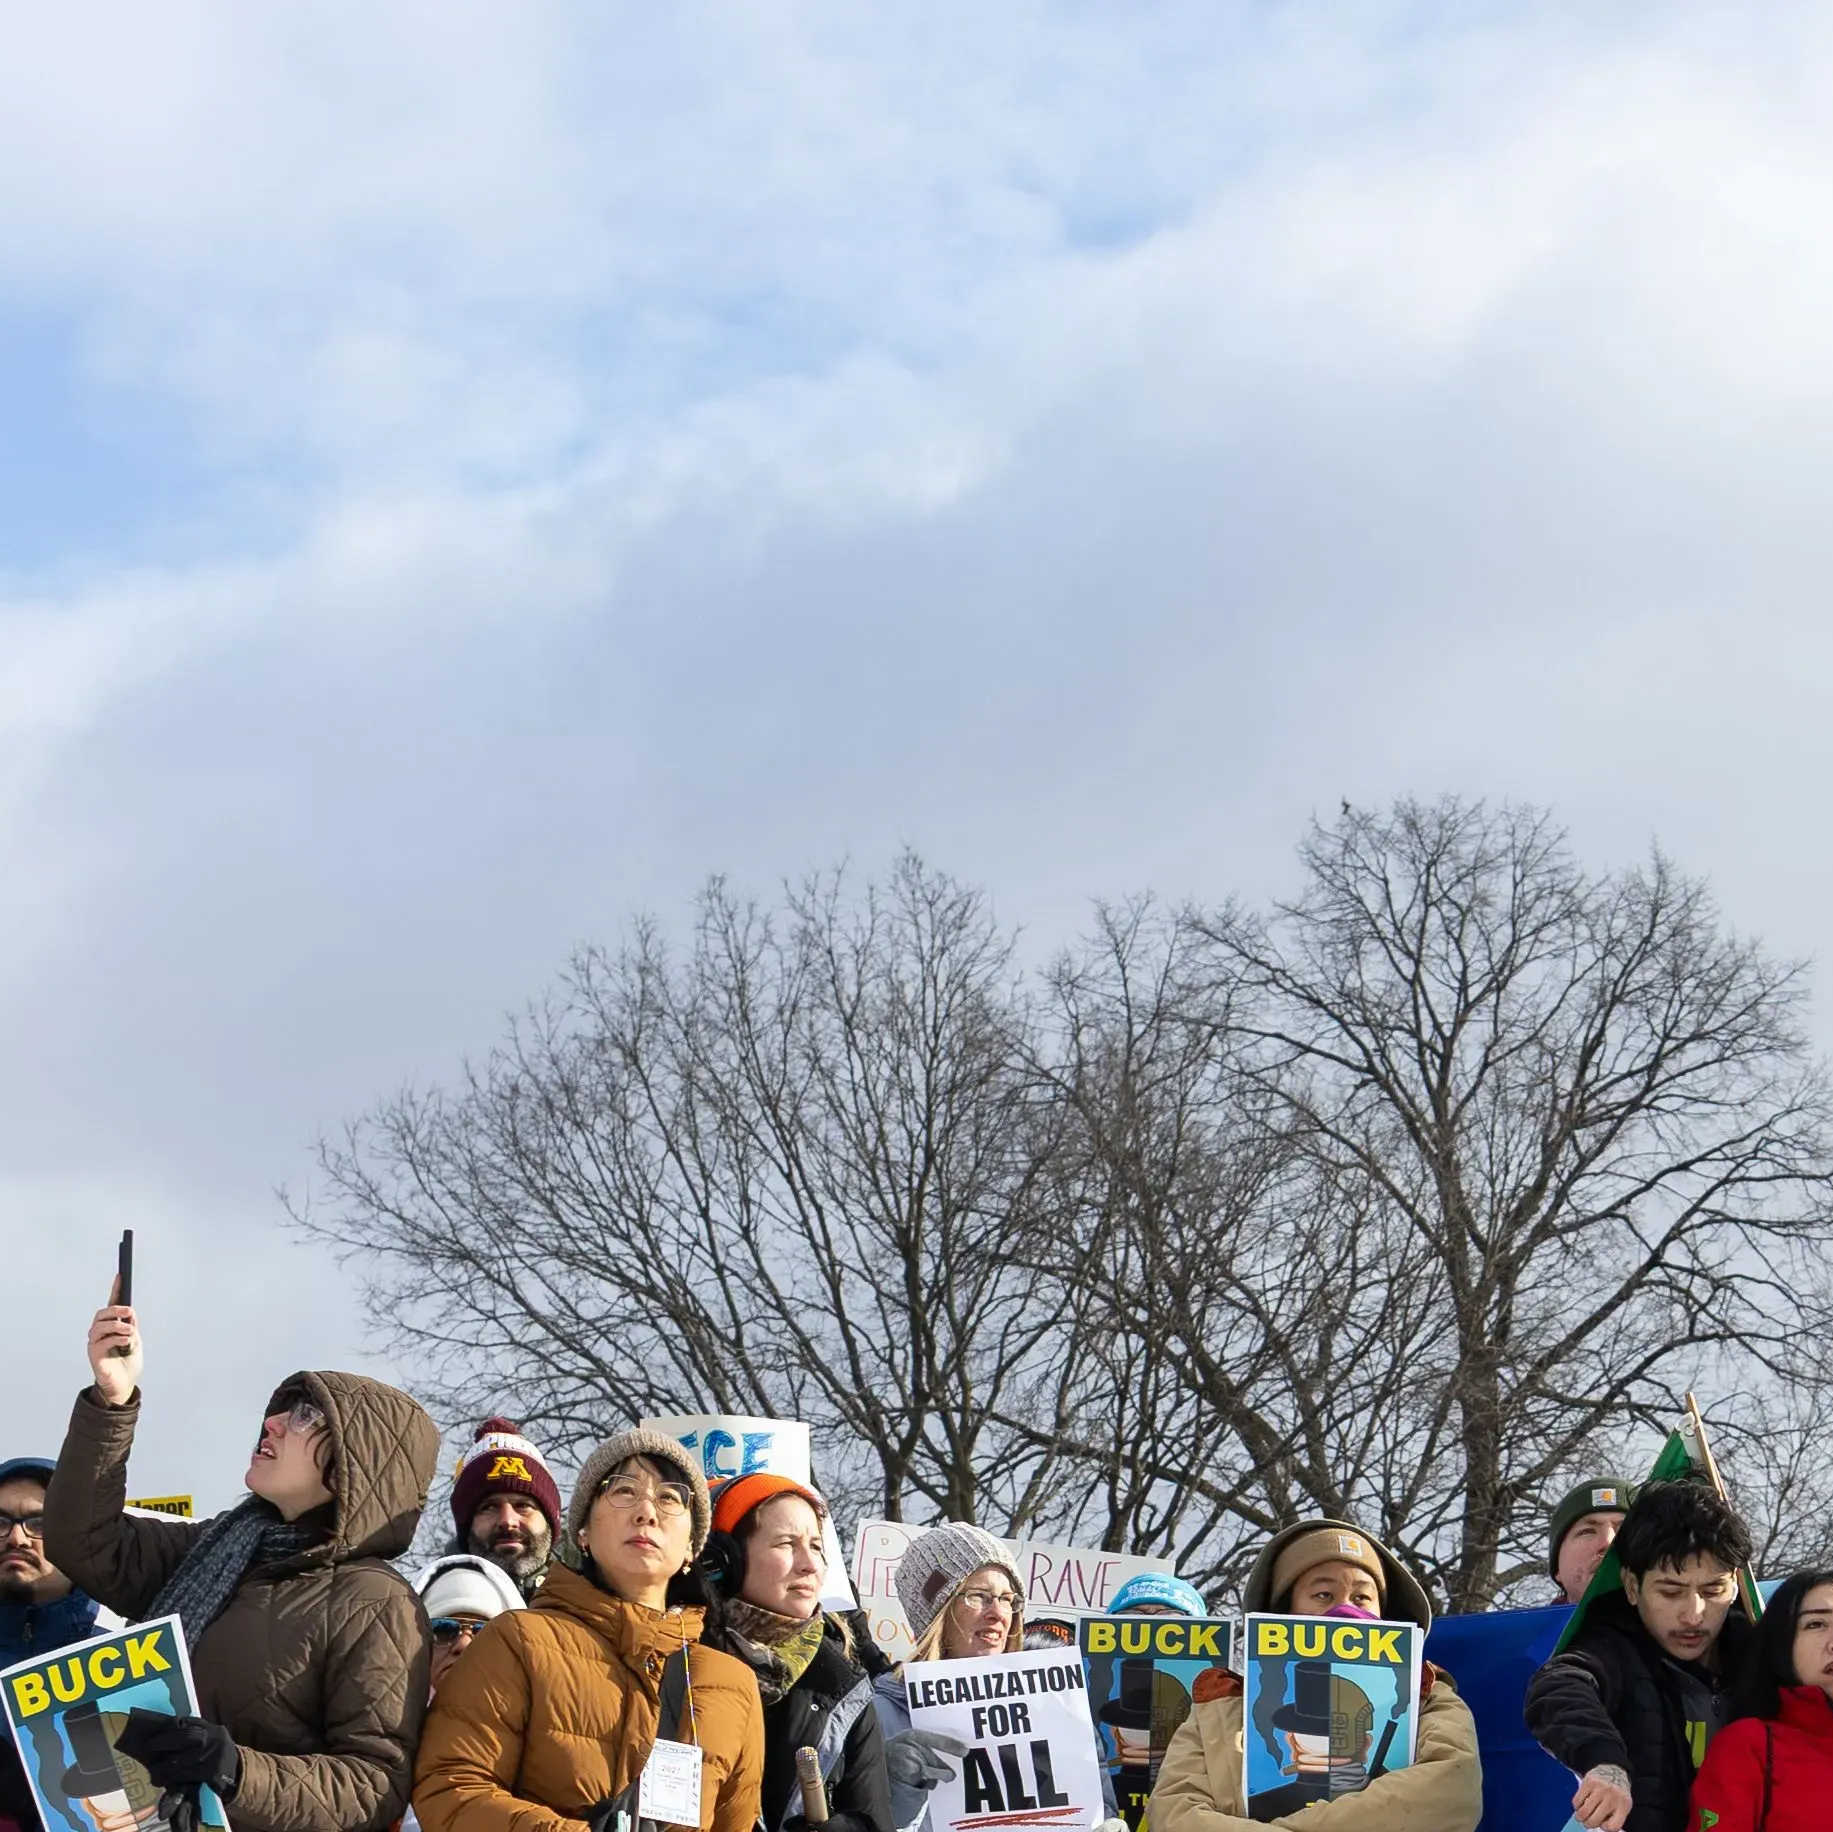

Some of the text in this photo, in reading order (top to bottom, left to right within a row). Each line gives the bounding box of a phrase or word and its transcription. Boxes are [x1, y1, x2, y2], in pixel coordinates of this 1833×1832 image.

[487, 1457, 532, 1482] M
[678, 1429, 776, 1477] CE
[1087, 1623, 1221, 1656] BUCK
[1257, 1623, 1403, 1663] BUCK
[11, 1630, 171, 1718] BUCK
[908, 1664, 1084, 1709] LEGALIZATION
[972, 1702, 1031, 1739] FOR
[962, 1740, 1069, 1814] ALL
